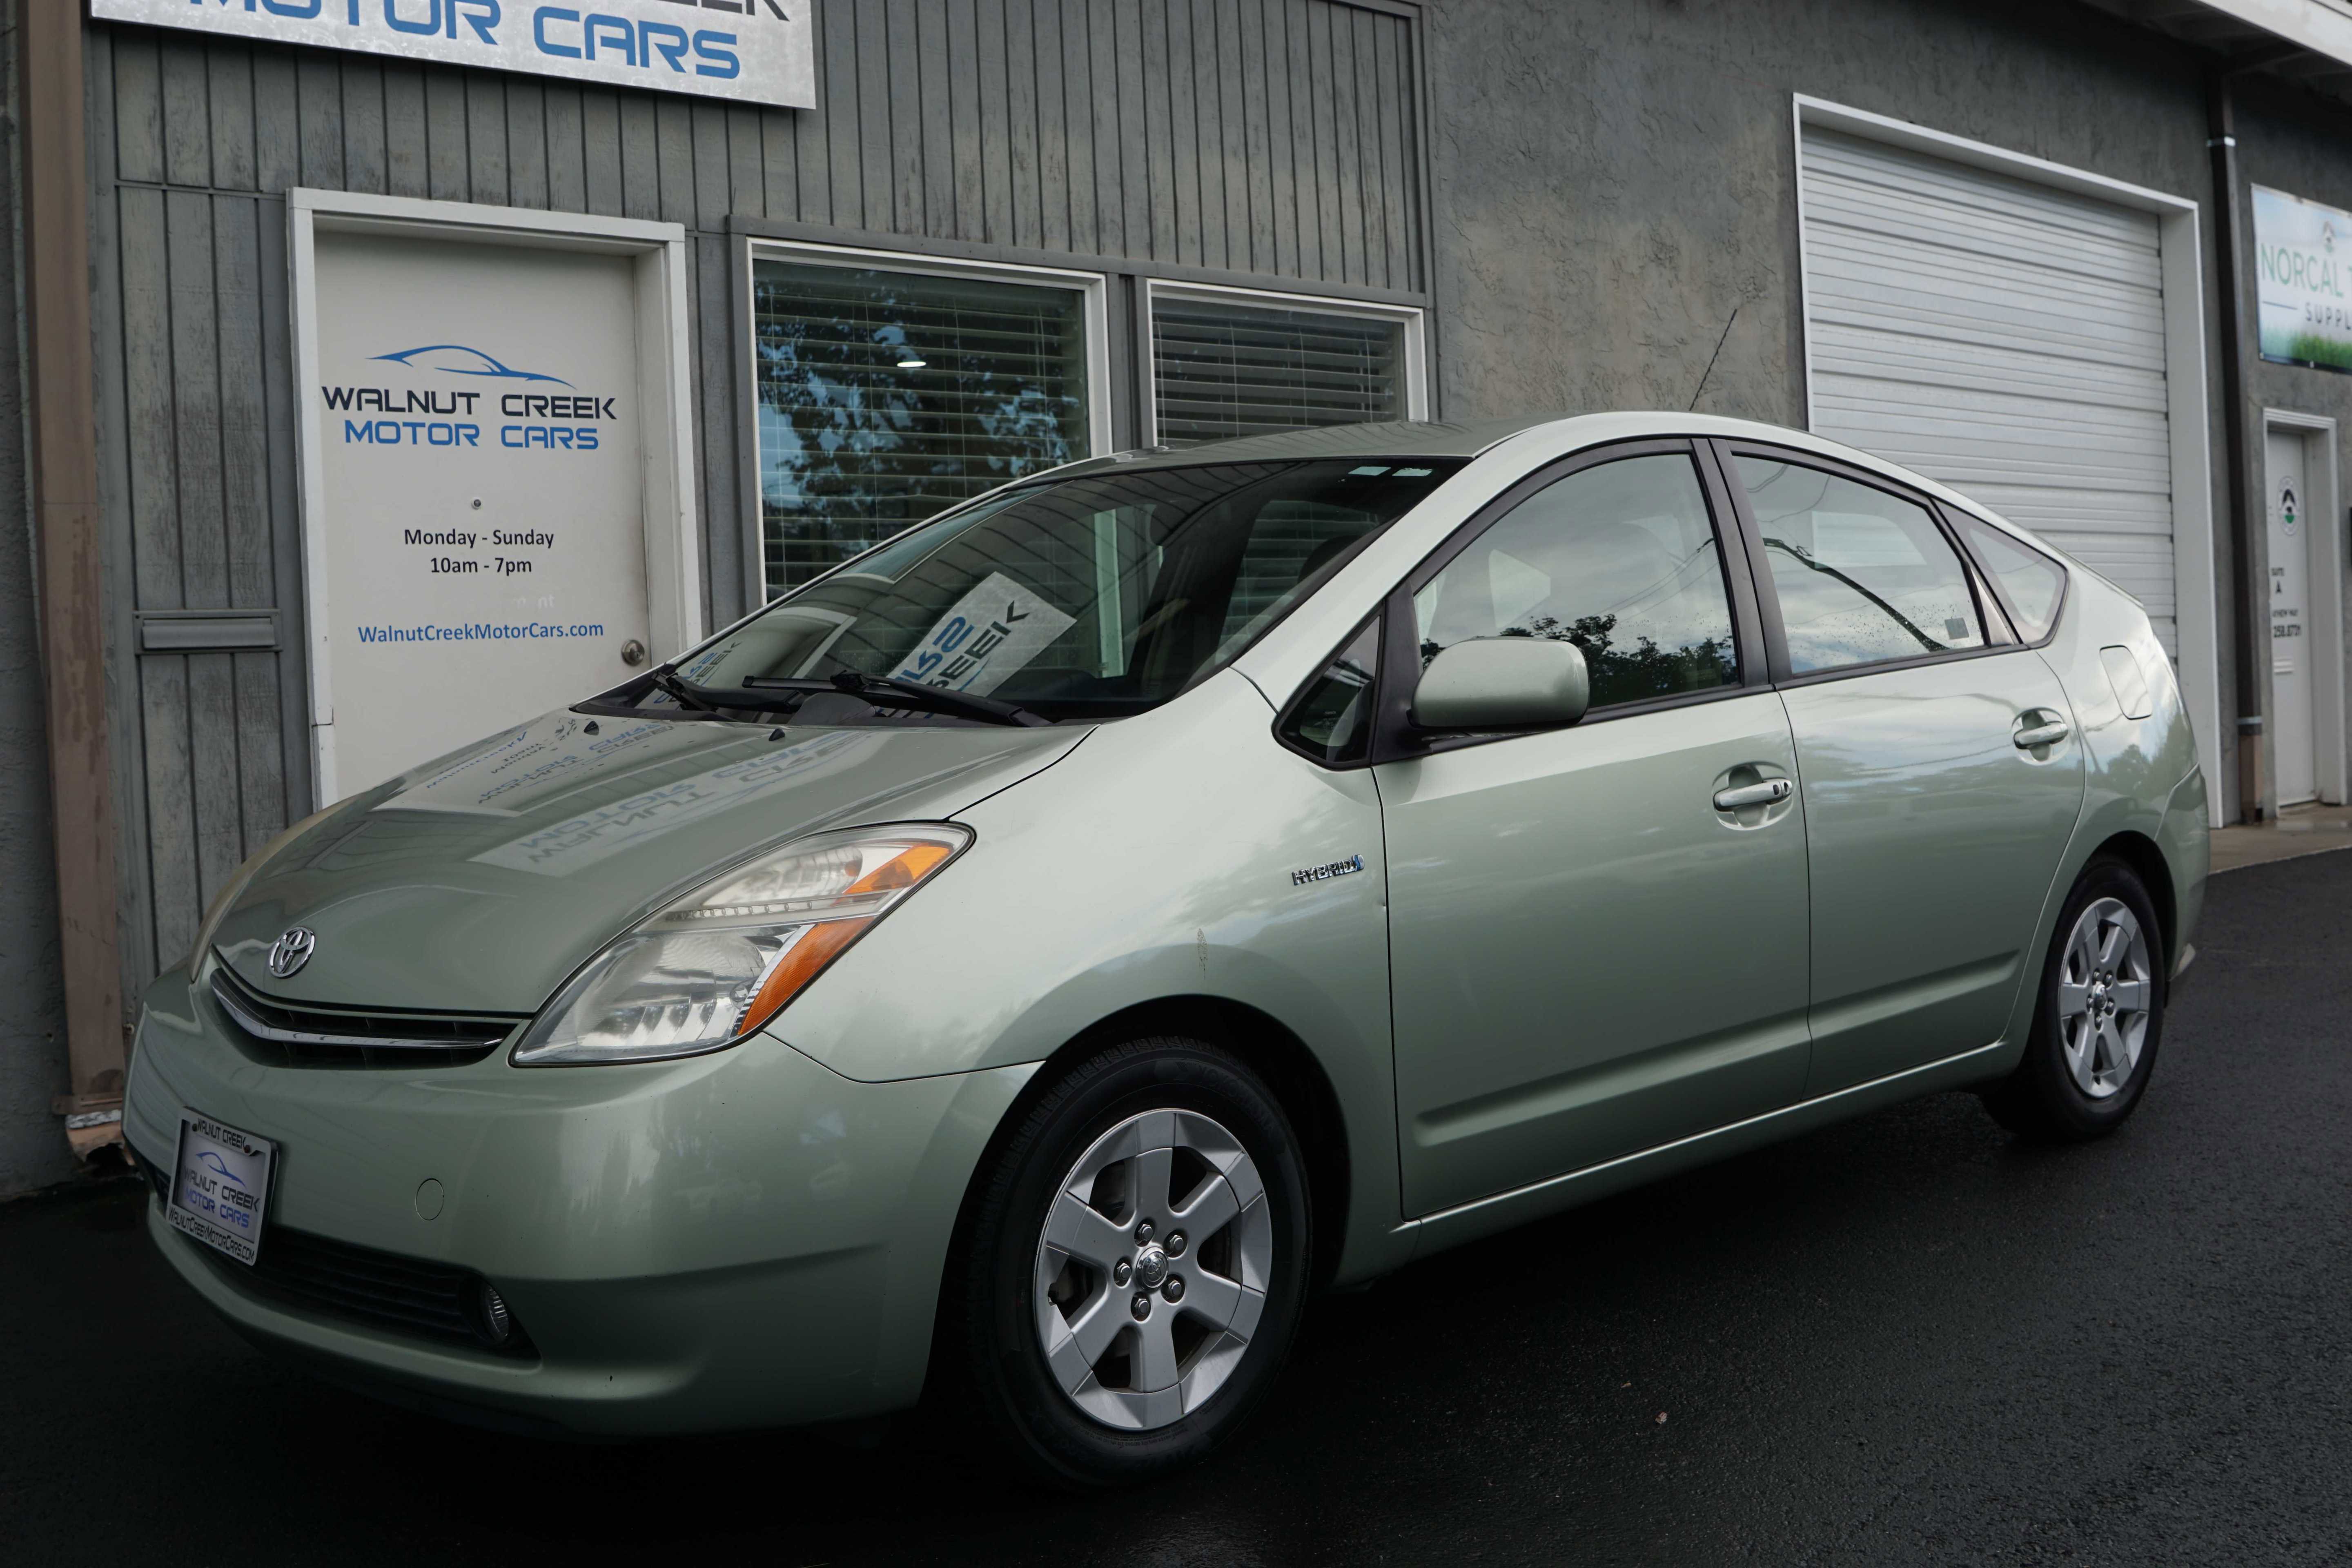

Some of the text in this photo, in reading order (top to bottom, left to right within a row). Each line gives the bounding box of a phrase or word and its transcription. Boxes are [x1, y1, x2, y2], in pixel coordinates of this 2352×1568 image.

[533, 6, 740, 79] CARS
[2261, 243, 2344, 298] NORCAL
[321, 386, 617, 420] WALNUT CREEK
[345, 420, 599, 450] MOTOR CARS
[404, 529, 477, 548] Monday
[492, 530, 554, 548] Sunday
[430, 558, 478, 573] 10am
[494, 558, 532, 576] 7pm
[358, 623, 604, 643] WalnutCreekMotorCars.com
[1292, 859, 1357, 885] HYBRID
[197, 1118, 247, 1149] WALNUT CREEK
[183, 1165, 260, 1212] WALNUT CREEK
[185, 1187, 250, 1228] MOTOR CARS
